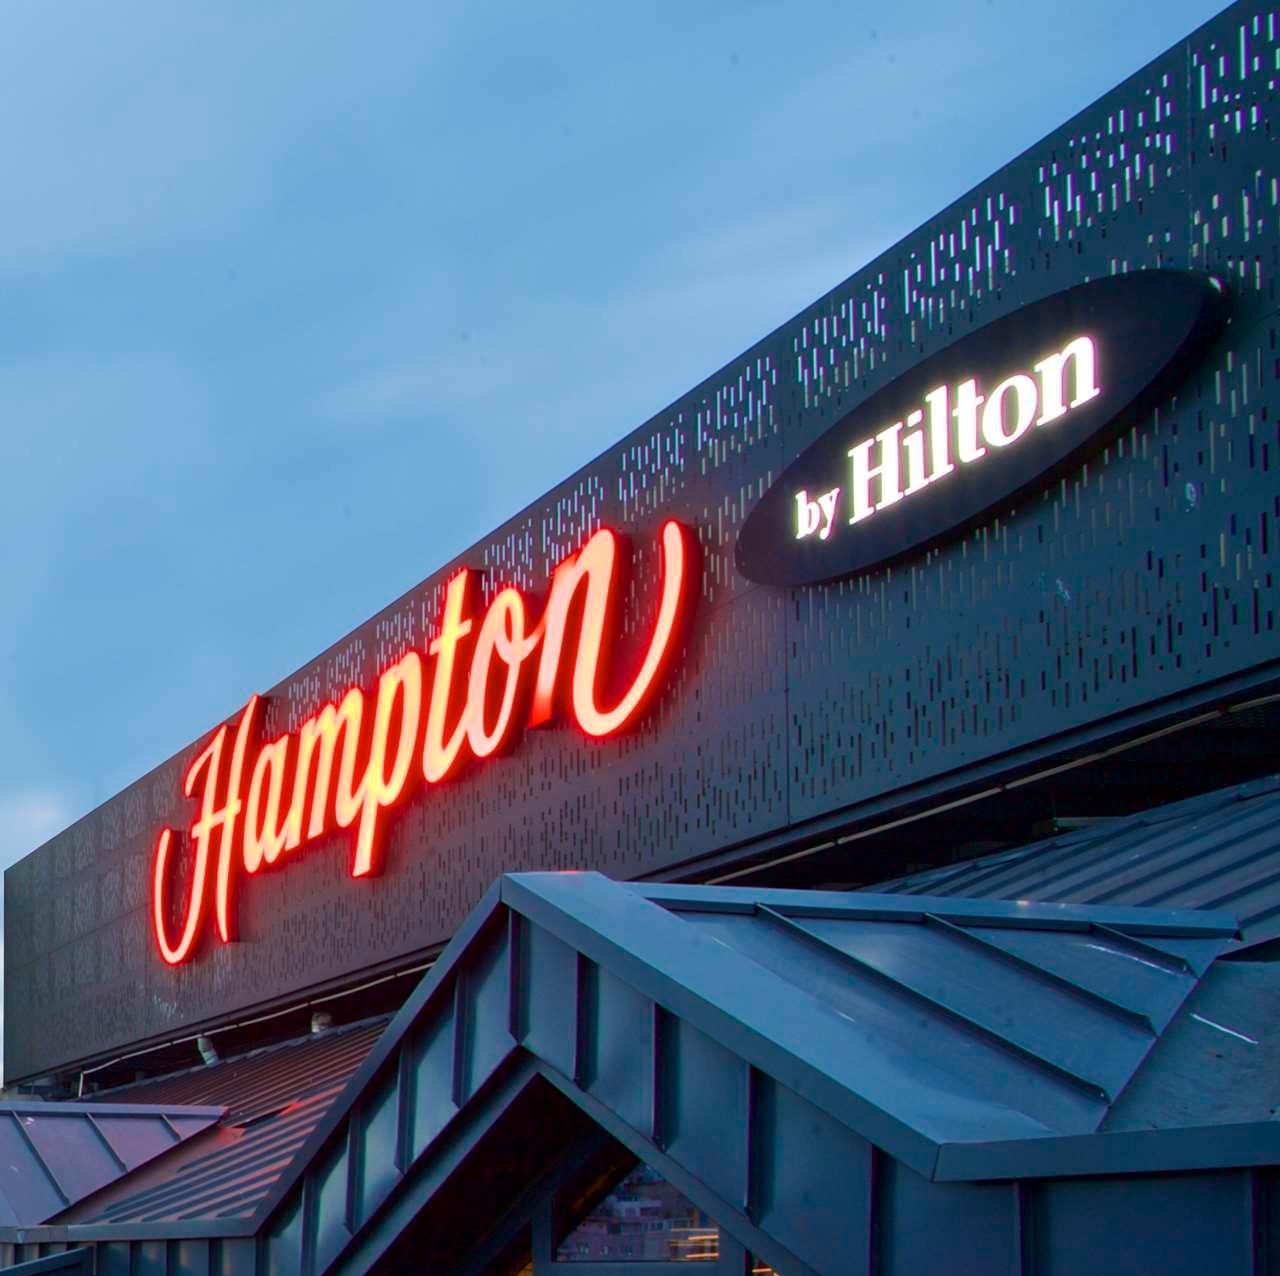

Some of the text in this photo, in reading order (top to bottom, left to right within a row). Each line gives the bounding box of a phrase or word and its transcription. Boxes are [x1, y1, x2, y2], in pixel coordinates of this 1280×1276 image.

[795, 336, 1101, 541] by Hilton
[152, 520, 690, 967] Hampton
